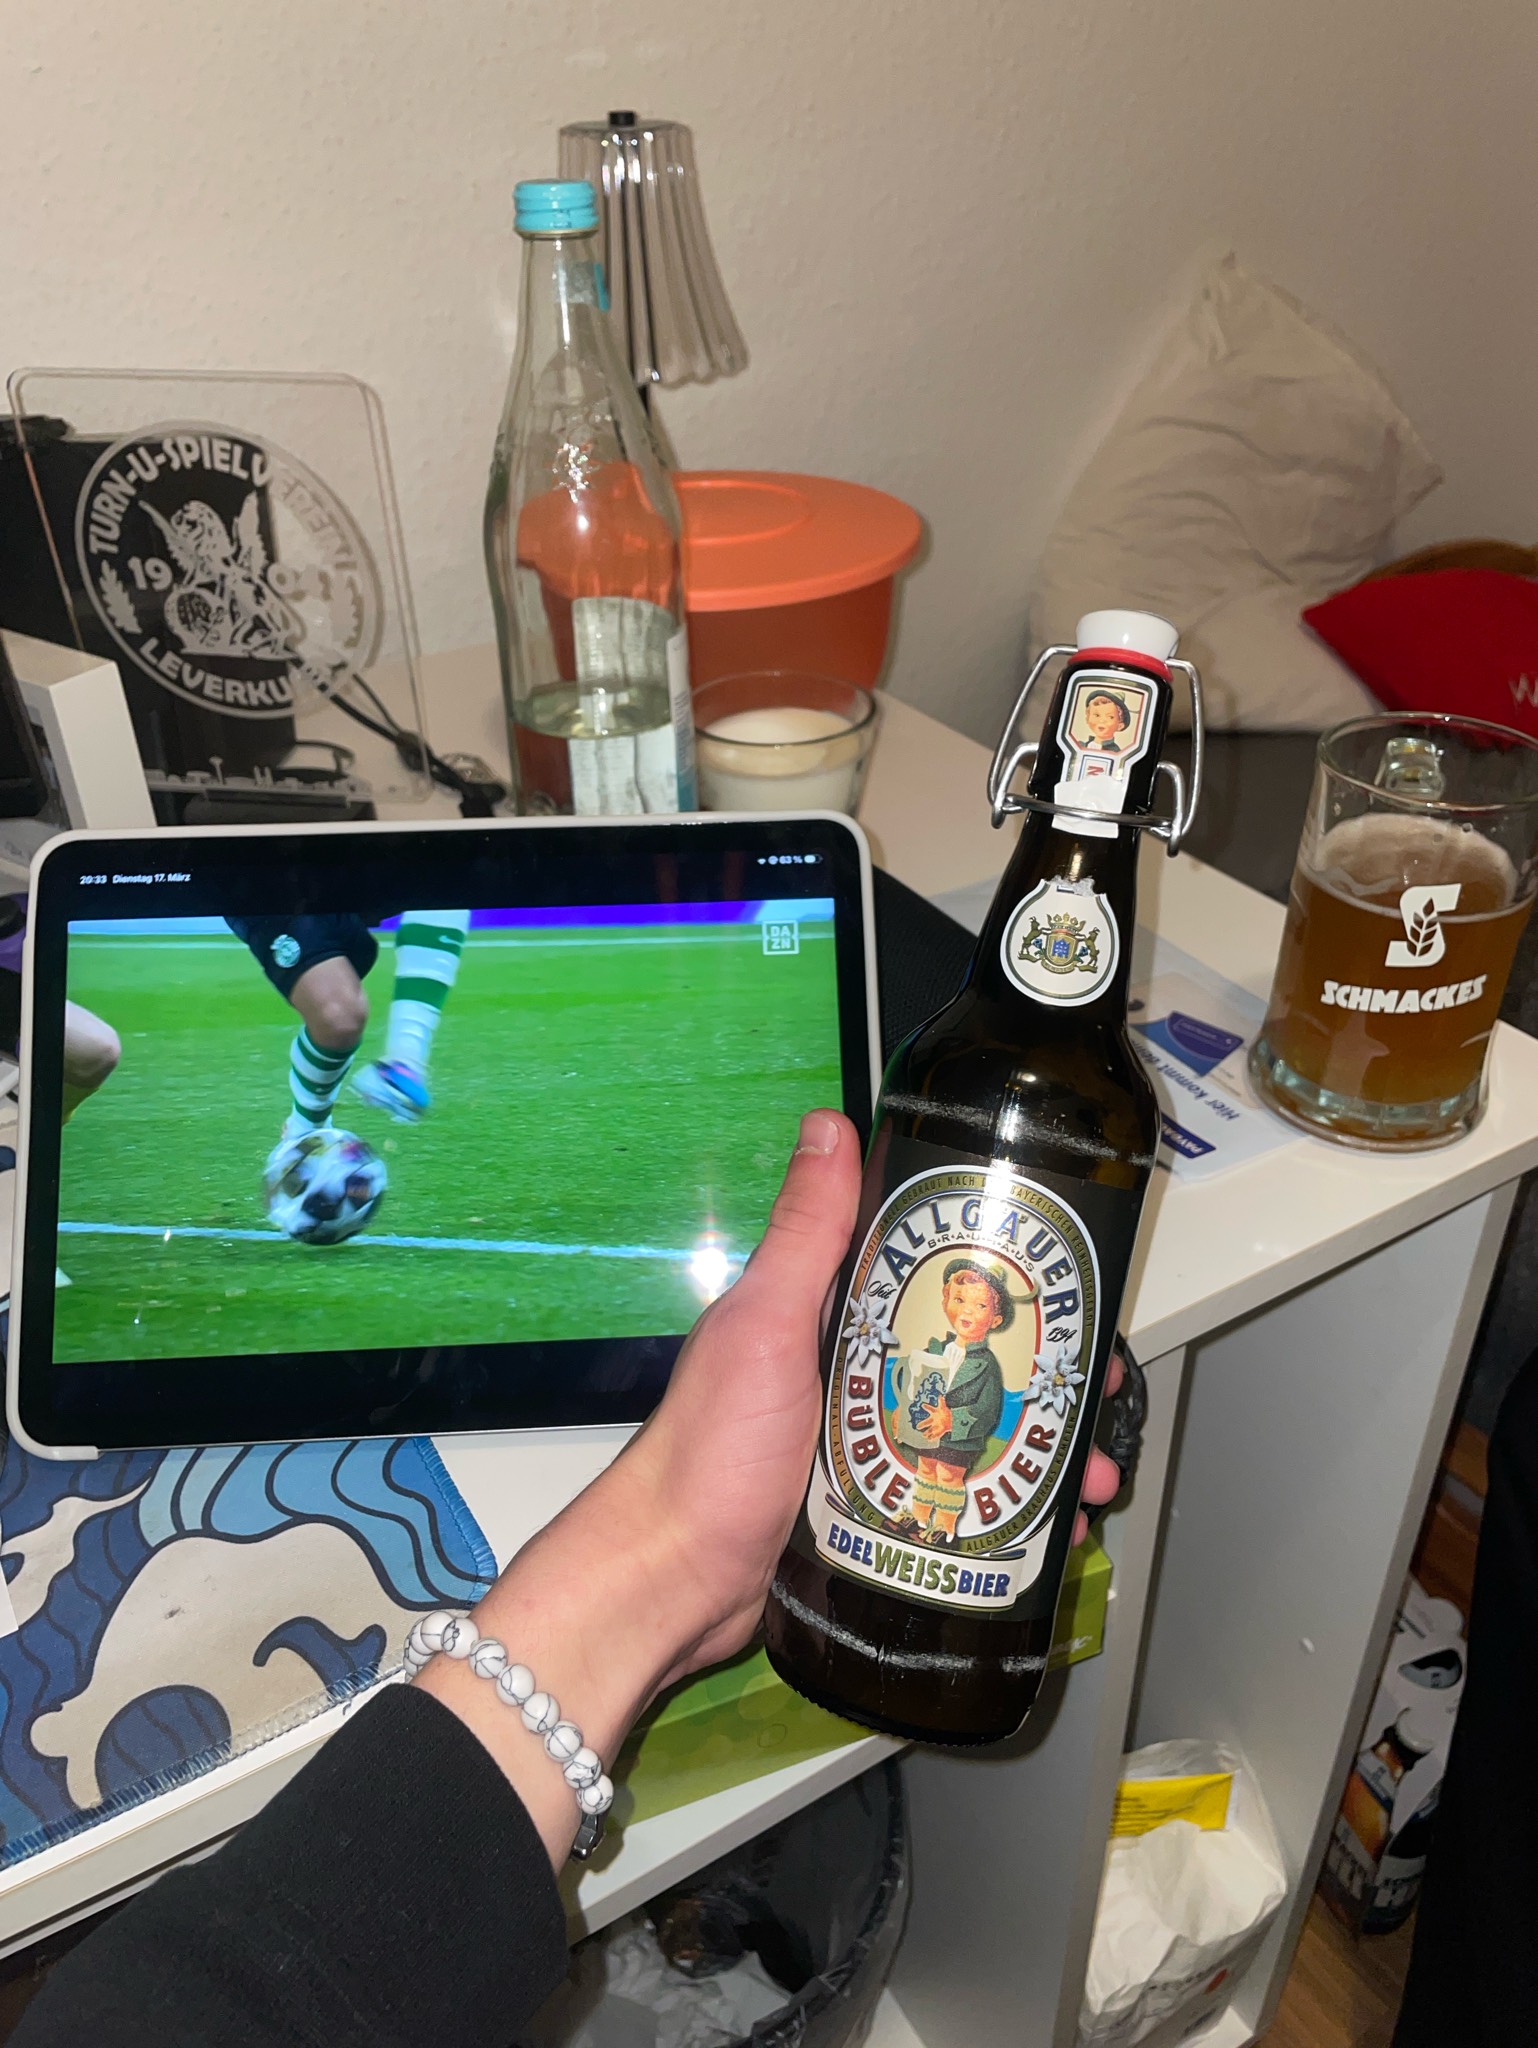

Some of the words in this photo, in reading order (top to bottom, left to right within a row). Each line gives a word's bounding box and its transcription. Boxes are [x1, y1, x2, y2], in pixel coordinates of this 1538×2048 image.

[127, 556, 173, 592] 19
[139, 636, 312, 706] LEVERKU
[80, 874, 107, 885] 20:33
[112, 873, 153, 885] Dienstag
[1320, 974, 1488, 1013] SCHMACKES
[1156, 1063, 1208, 1102] kommt
[1206, 1098, 1241, 1122] Hier
[861, 1205, 901, 1271] TRADITIONELL
[902, 1179, 942, 1205] GEBRAUT
[947, 1175, 975, 1187] NACH
[1010, 1185, 1074, 1234] BAYERISCHEN
[1071, 1234, 1095, 1328] REINHEITSGEBOT
[881, 1198, 1080, 1324] ALLGÄUER
[867, 1280, 897, 1300] Seit
[1046, 1326, 1078, 1344] 1394
[847, 1374, 912, 1511] BÜBLE
[973, 1423, 1057, 1525] BIER
[966, 1521, 1020, 1553] ALLGÄUER
[1020, 1468, 1058, 1523] BRAUHAUS
[827, 1522, 1011, 1598] EDELWEISSBIER
